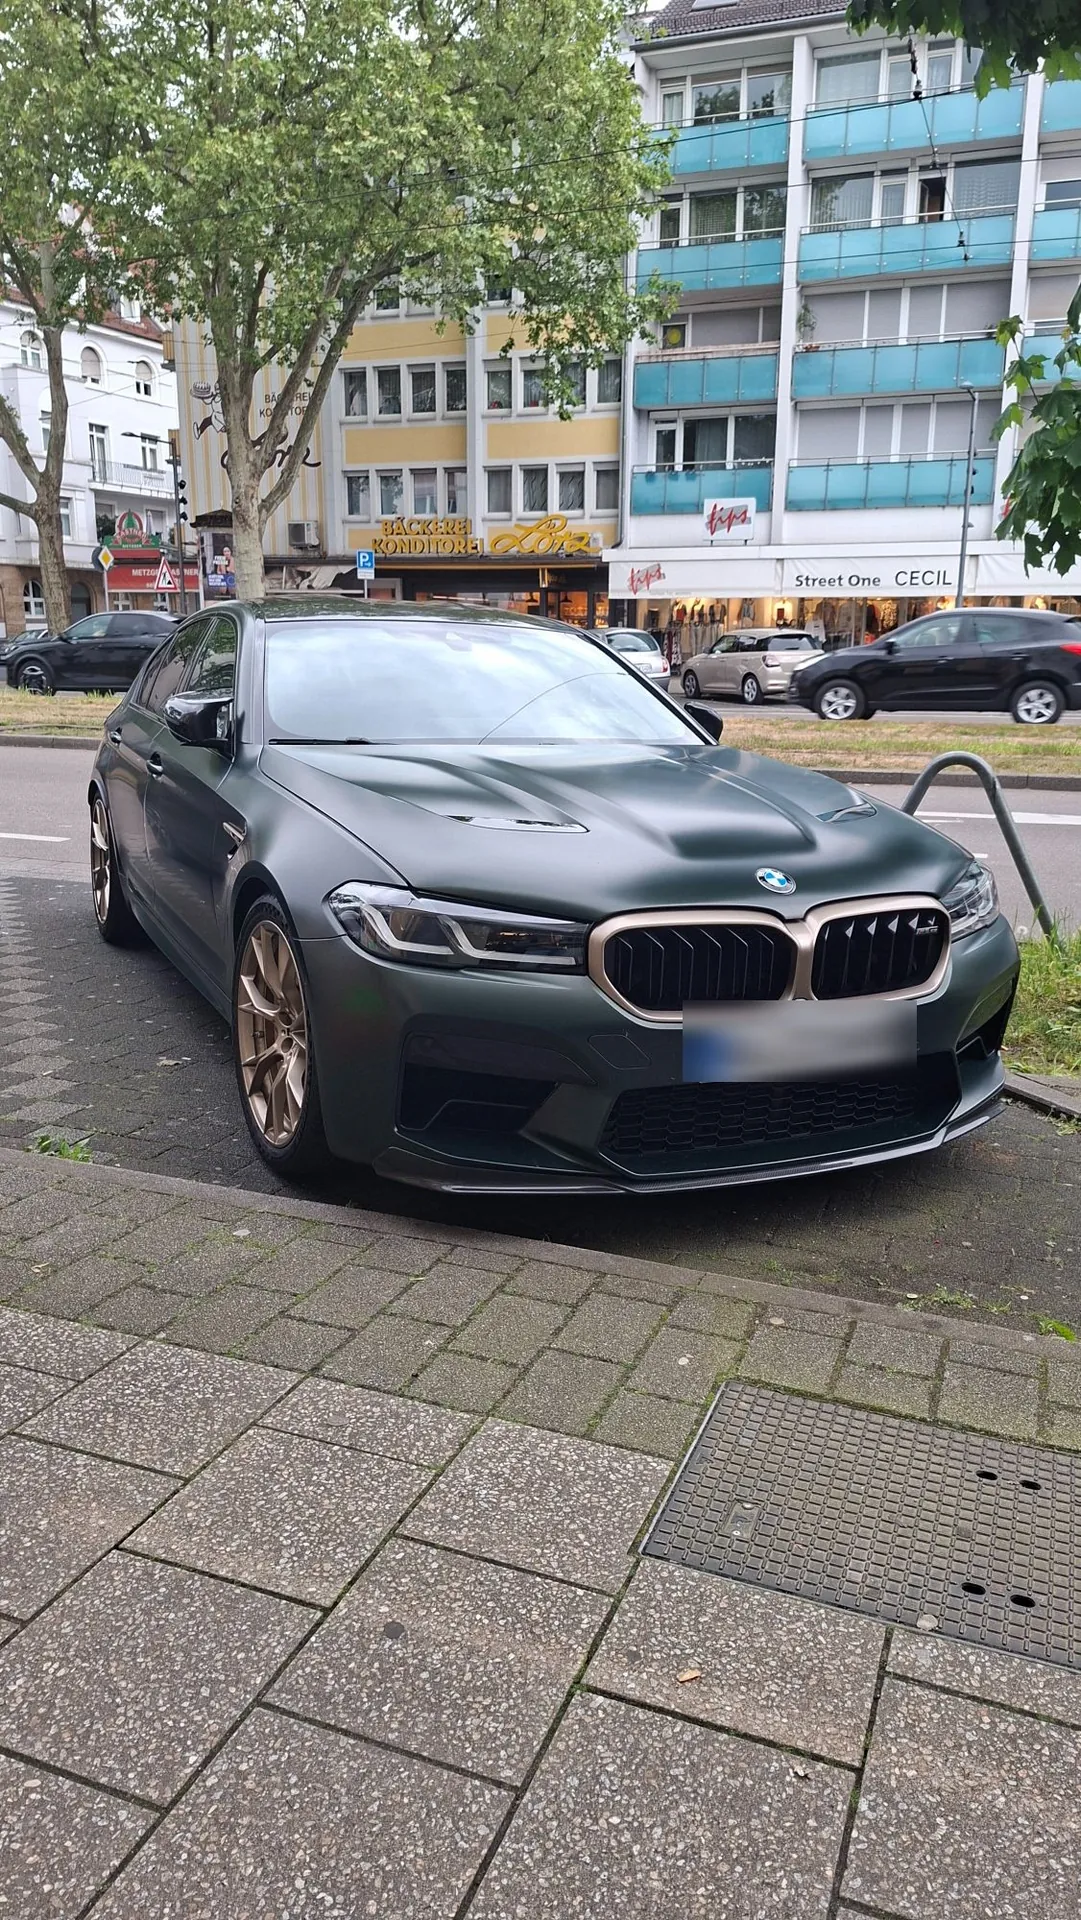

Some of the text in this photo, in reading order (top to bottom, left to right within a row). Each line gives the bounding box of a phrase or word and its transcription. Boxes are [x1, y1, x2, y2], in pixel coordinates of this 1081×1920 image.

[264, 391, 312, 404] BÄCREI
[381, 516, 472, 535] BÄCKEREI
[372, 537, 484, 554] KONDITOREI
[360, 552, 369, 567] P
[795, 570, 952, 587] Street One CECIL
